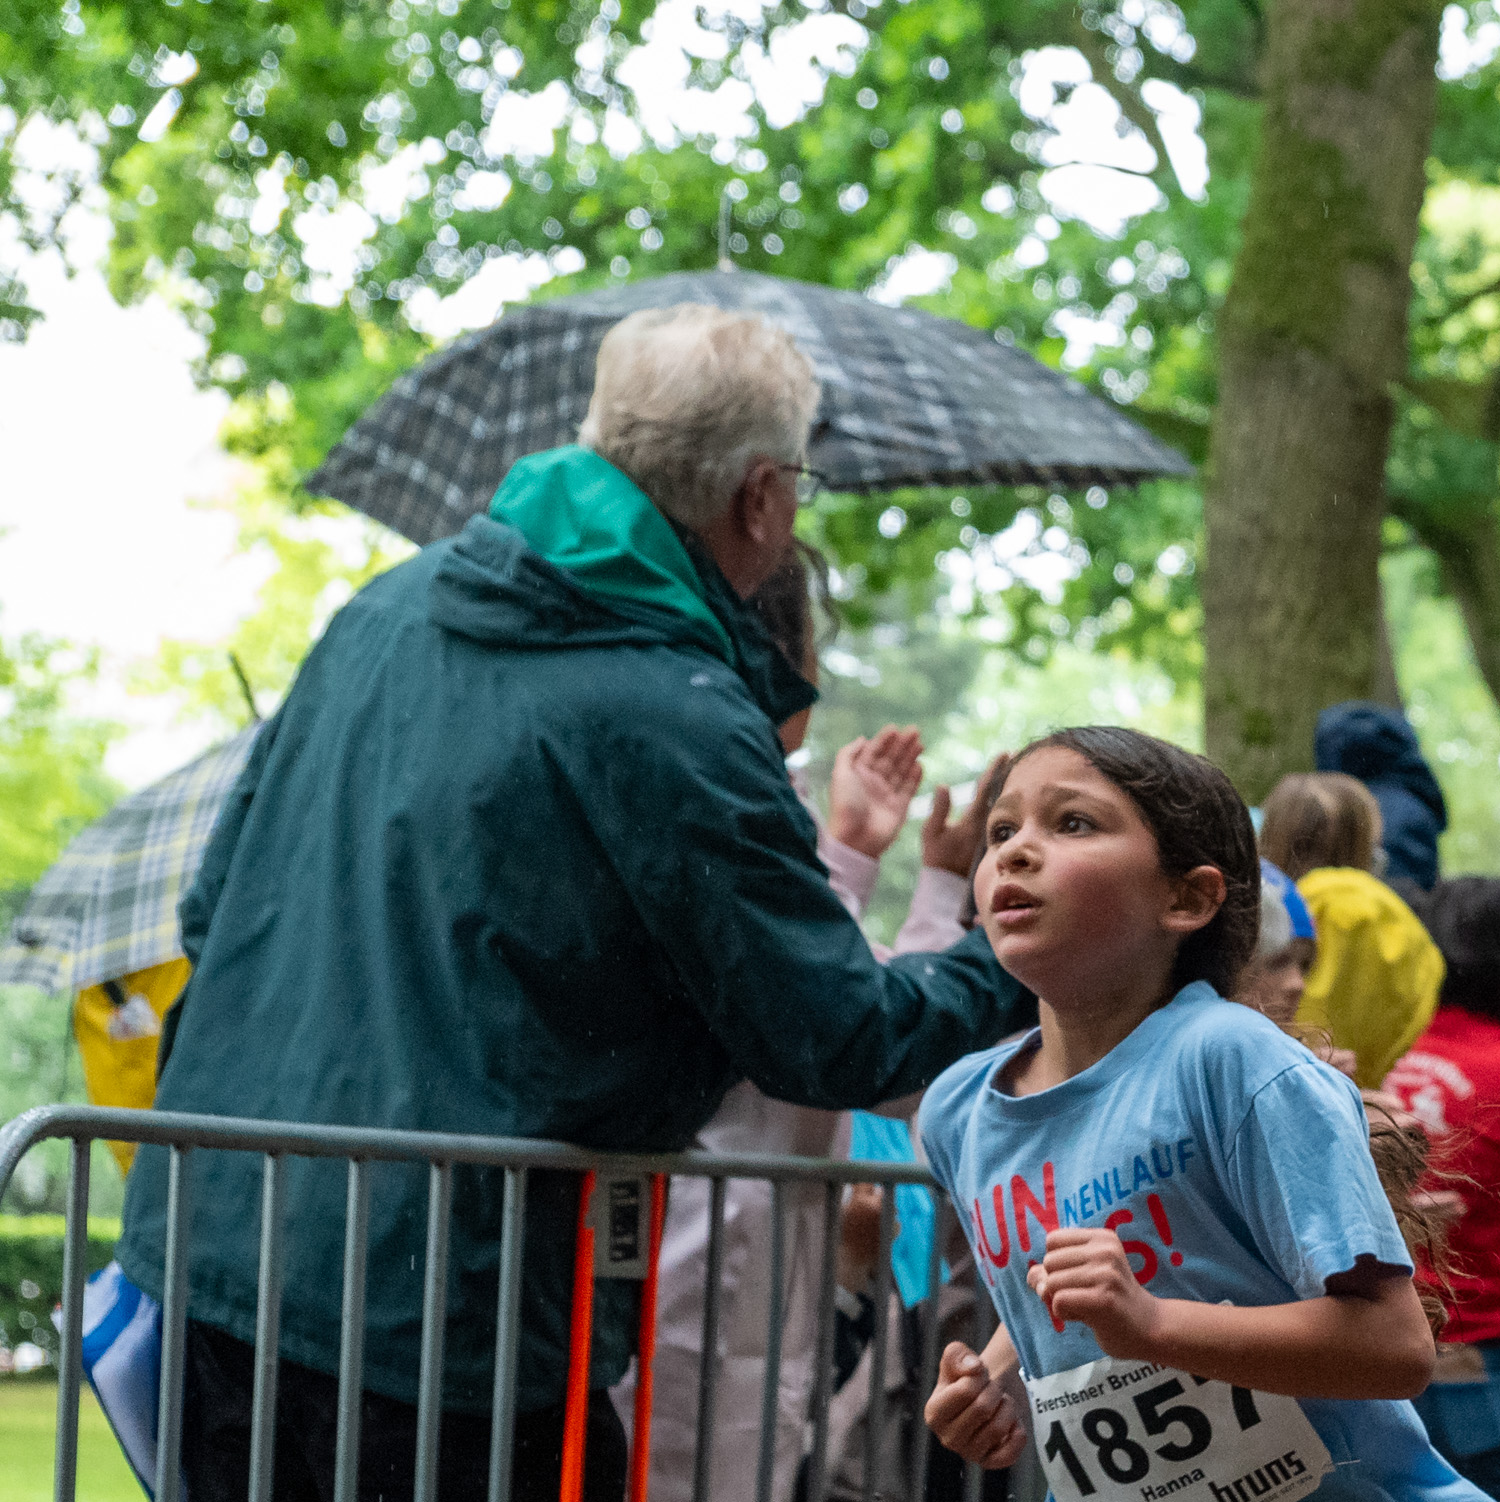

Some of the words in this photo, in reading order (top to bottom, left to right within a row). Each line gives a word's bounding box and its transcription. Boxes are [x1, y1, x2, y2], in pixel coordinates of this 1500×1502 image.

[970, 1161, 1061, 1287] UN
[1063, 1138, 1195, 1228] NENLAUF
[1044, 1375, 1262, 1497] 1857
[1140, 1467, 1206, 1502] Hanna
